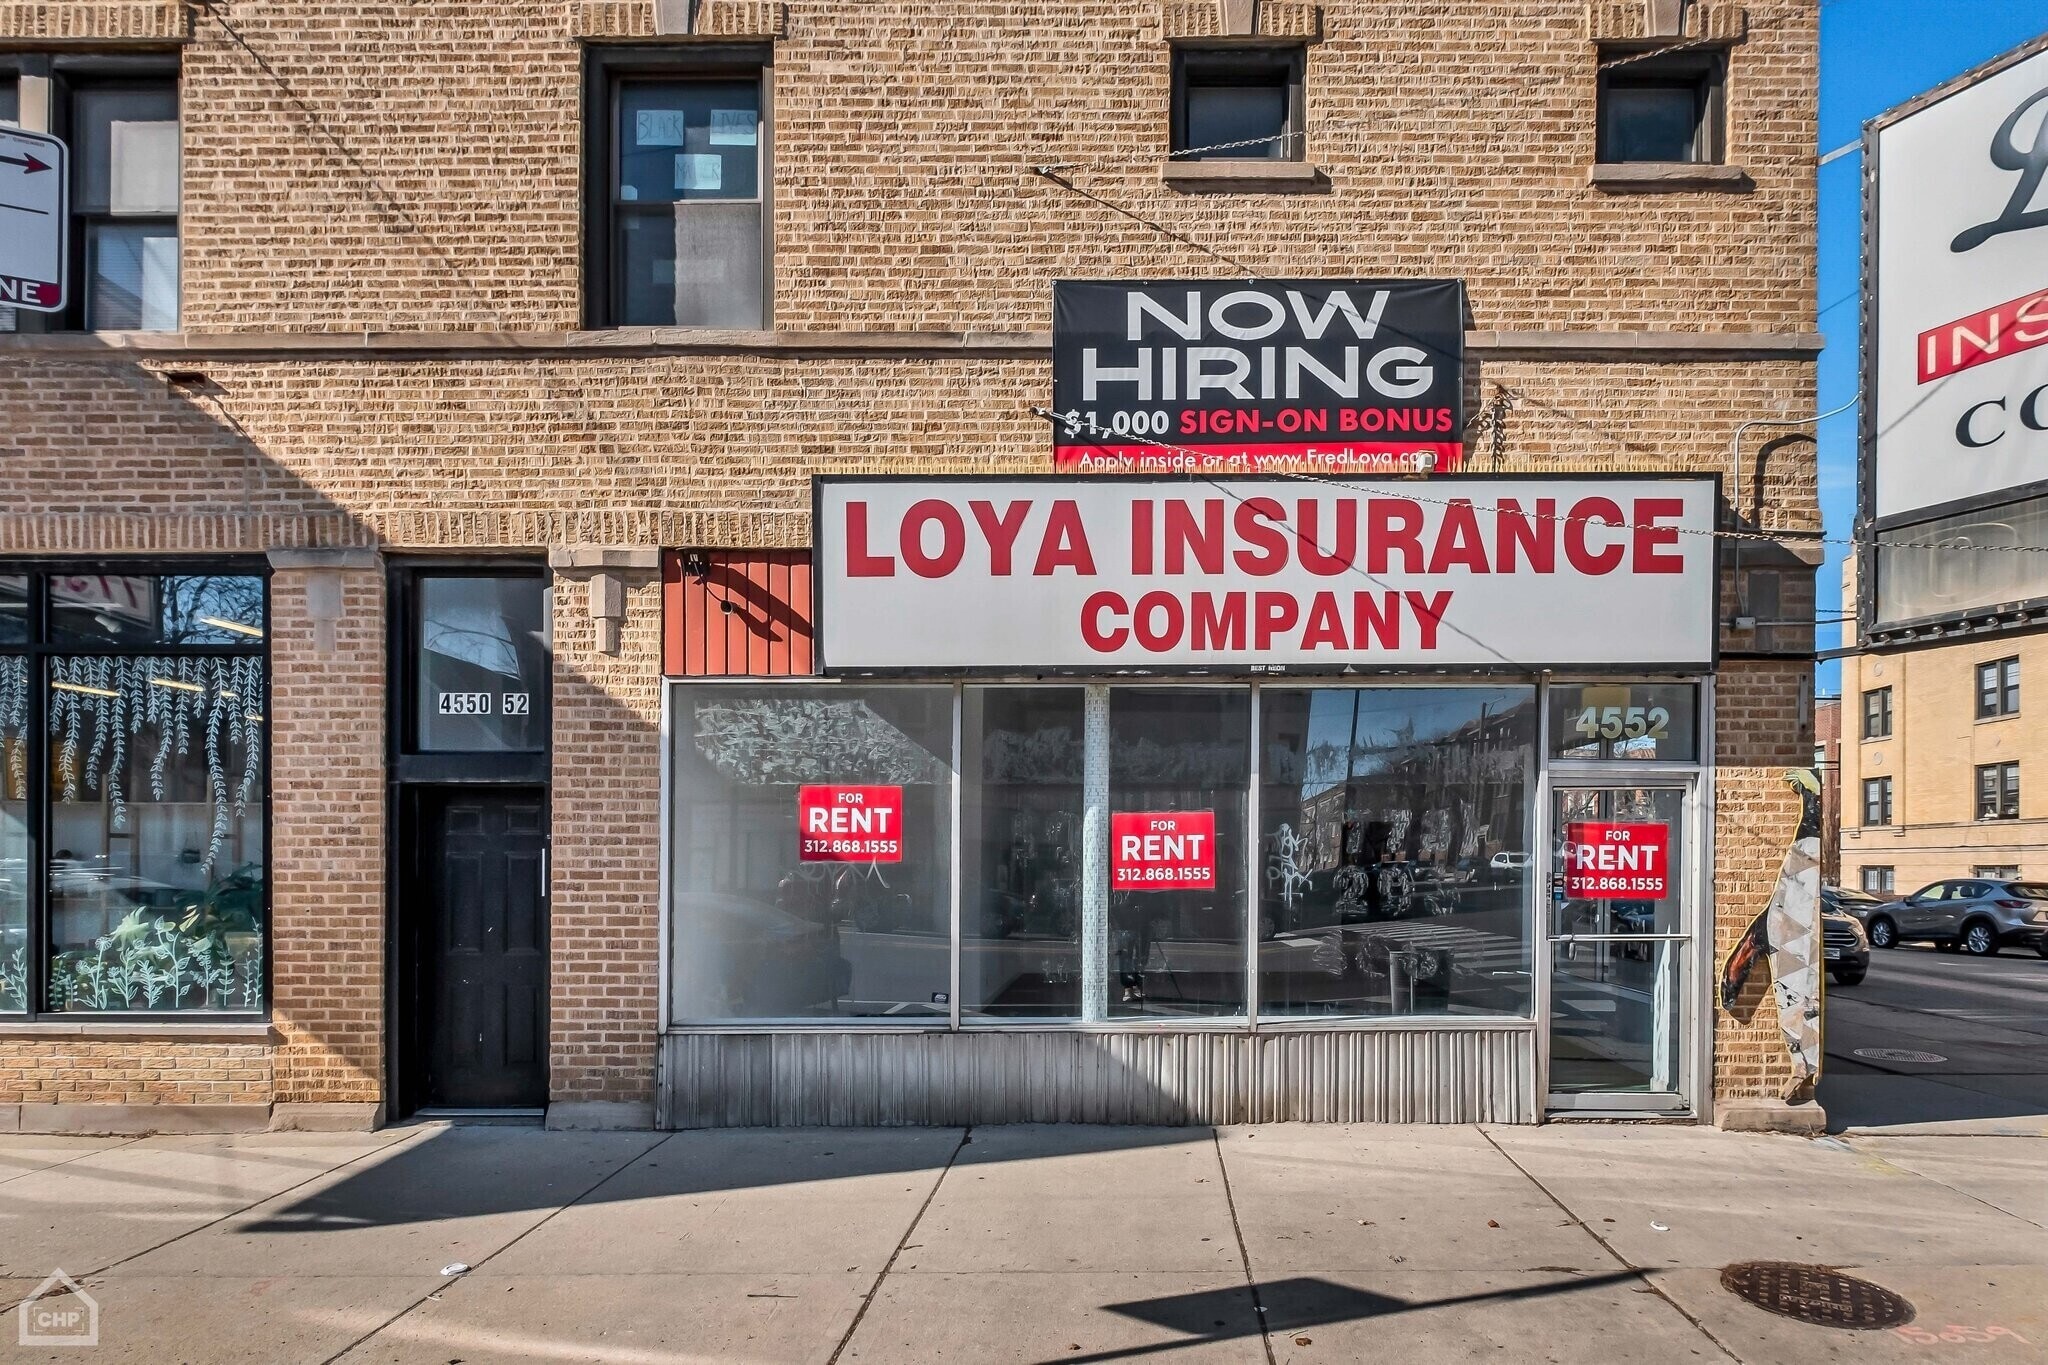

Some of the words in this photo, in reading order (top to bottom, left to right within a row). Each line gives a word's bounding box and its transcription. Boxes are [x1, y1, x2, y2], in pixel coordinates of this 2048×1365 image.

[638, 113, 682, 140] BLACK
[711, 113, 756, 135] LIVES
[1127, 290, 1391, 341] NOW
[1082, 346, 1434, 401] HIRING
[1063, 409, 1170, 439] $1,000
[1179, 408, 1328, 435] SIGN-ON
[1339, 407, 1453, 433] BONUS
[1080, 452, 1132, 472] Apply
[1140, 451, 1196, 468] inside
[1228, 451, 1248, 465] at
[846, 499, 1097, 578] LOYA
[1131, 496, 1684, 577] INSURANCE
[1080, 590, 1454, 653] COMPANY
[440, 693, 490, 713] 4550
[504, 694, 528, 714] 52
[1575, 706, 1670, 740] 4552
[838, 792, 864, 804] FOR
[809, 807, 893, 833] RENT
[1150, 820, 1176, 831] FOR
[804, 839, 898, 853] 312.868.1555
[1121, 834, 1205, 861] RENT
[1605, 830, 1631, 841] FOR
[1576, 844, 1659, 871] RENT
[1117, 867, 1210, 881] 312.868.1555
[1571, 876, 1663, 891] 312.868.1555
